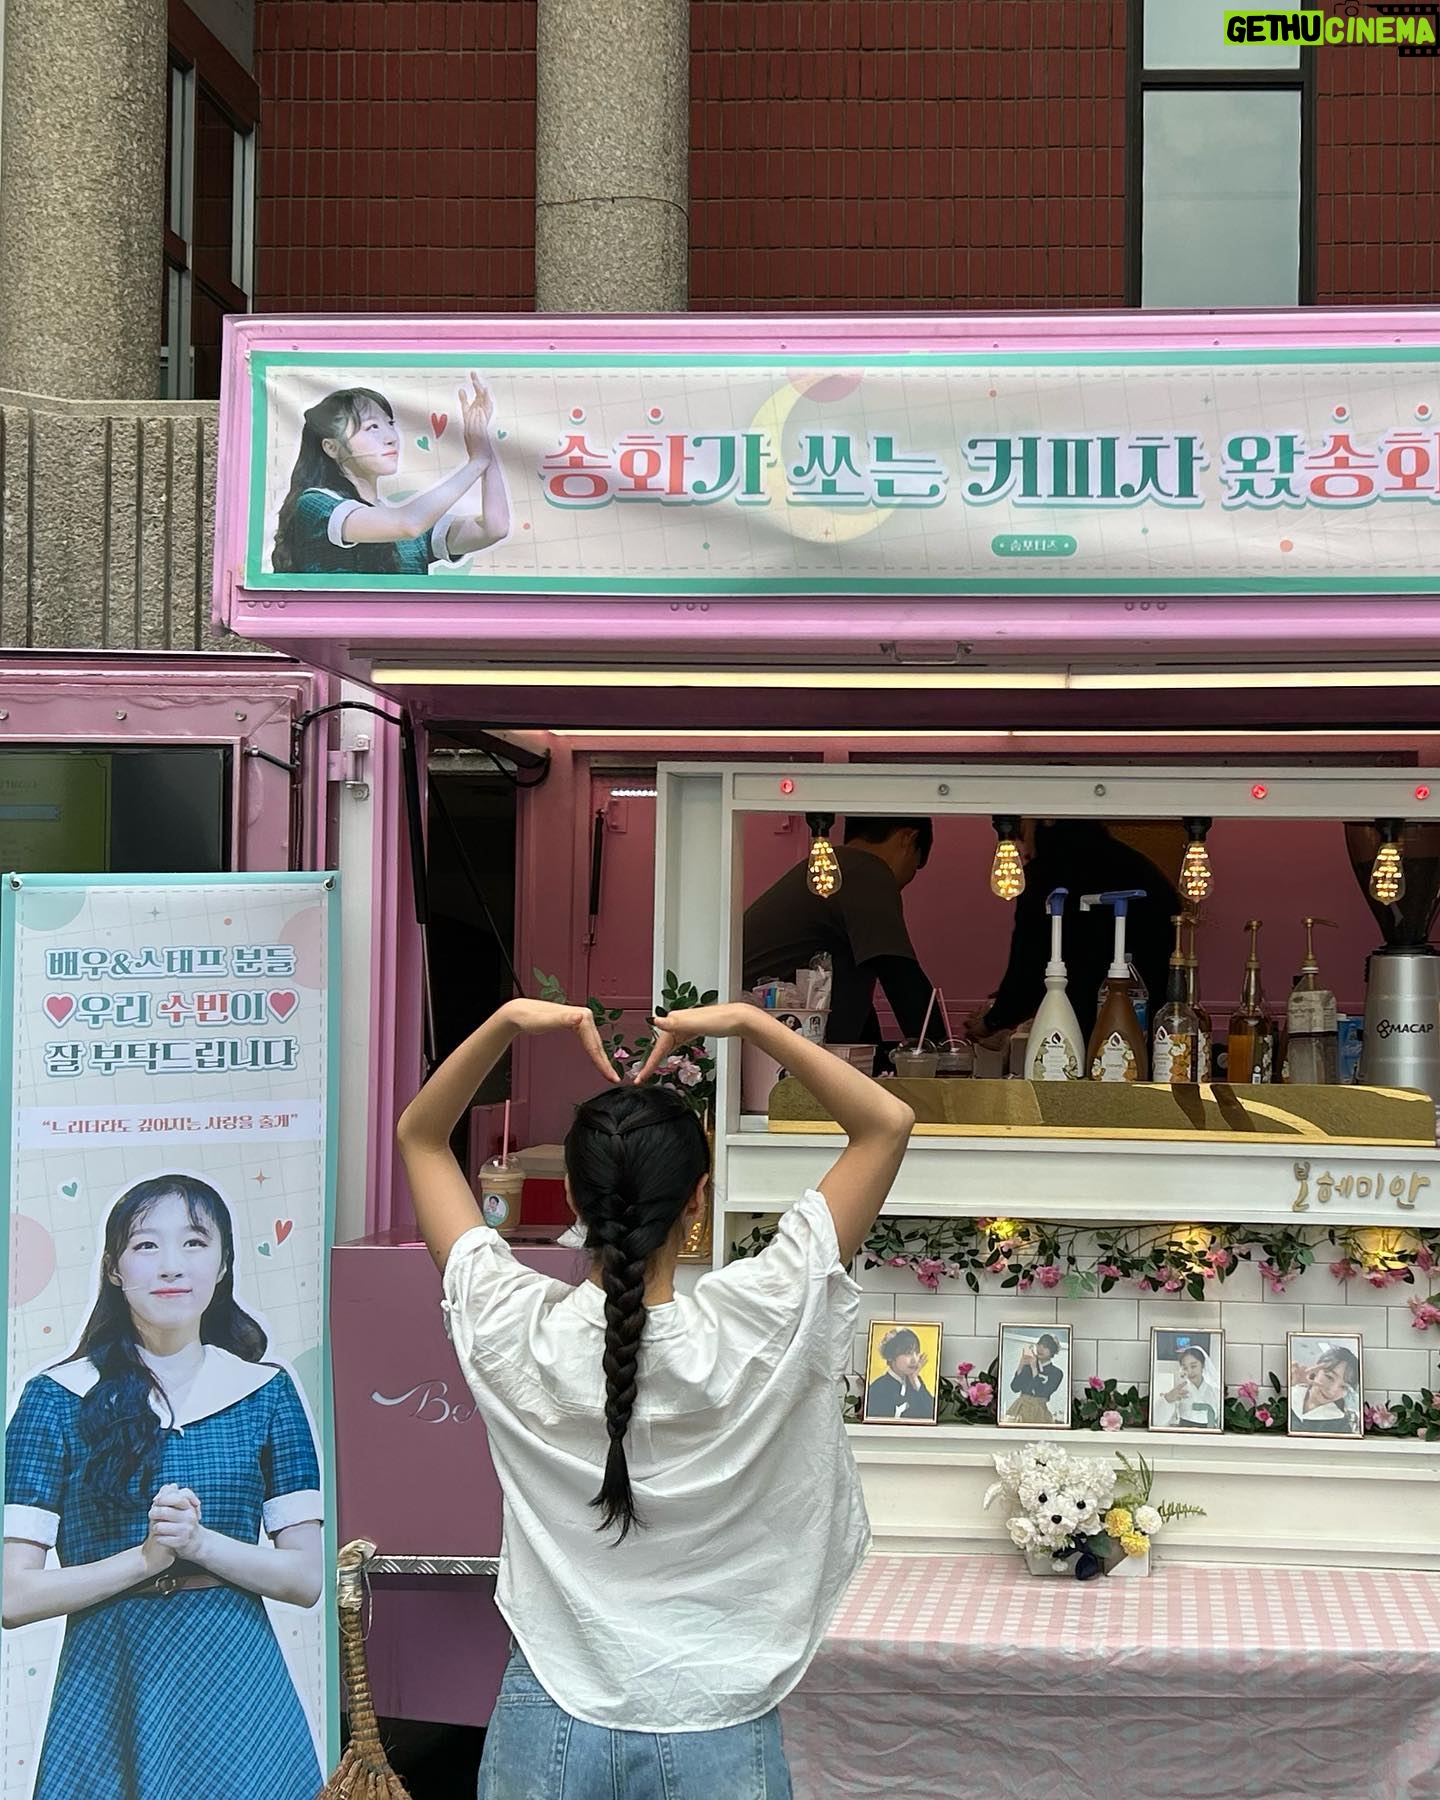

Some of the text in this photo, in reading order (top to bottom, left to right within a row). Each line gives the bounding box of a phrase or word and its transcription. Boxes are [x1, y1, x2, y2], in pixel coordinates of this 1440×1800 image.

[543, 428, 772, 500] 송화가
[791, 434, 943, 498] 쏘는
[967, 435, 1205, 499] 커피차
[49, 947, 294, 977] 배우&스태프 분들
[81, 993, 266, 1025] 우리 수빈이
[1389, 1023, 1434, 1033] MACAP
[48, 1039, 296, 1072] 잘 부탁드립니다
[205, 1115, 253, 1130] 사랑을
